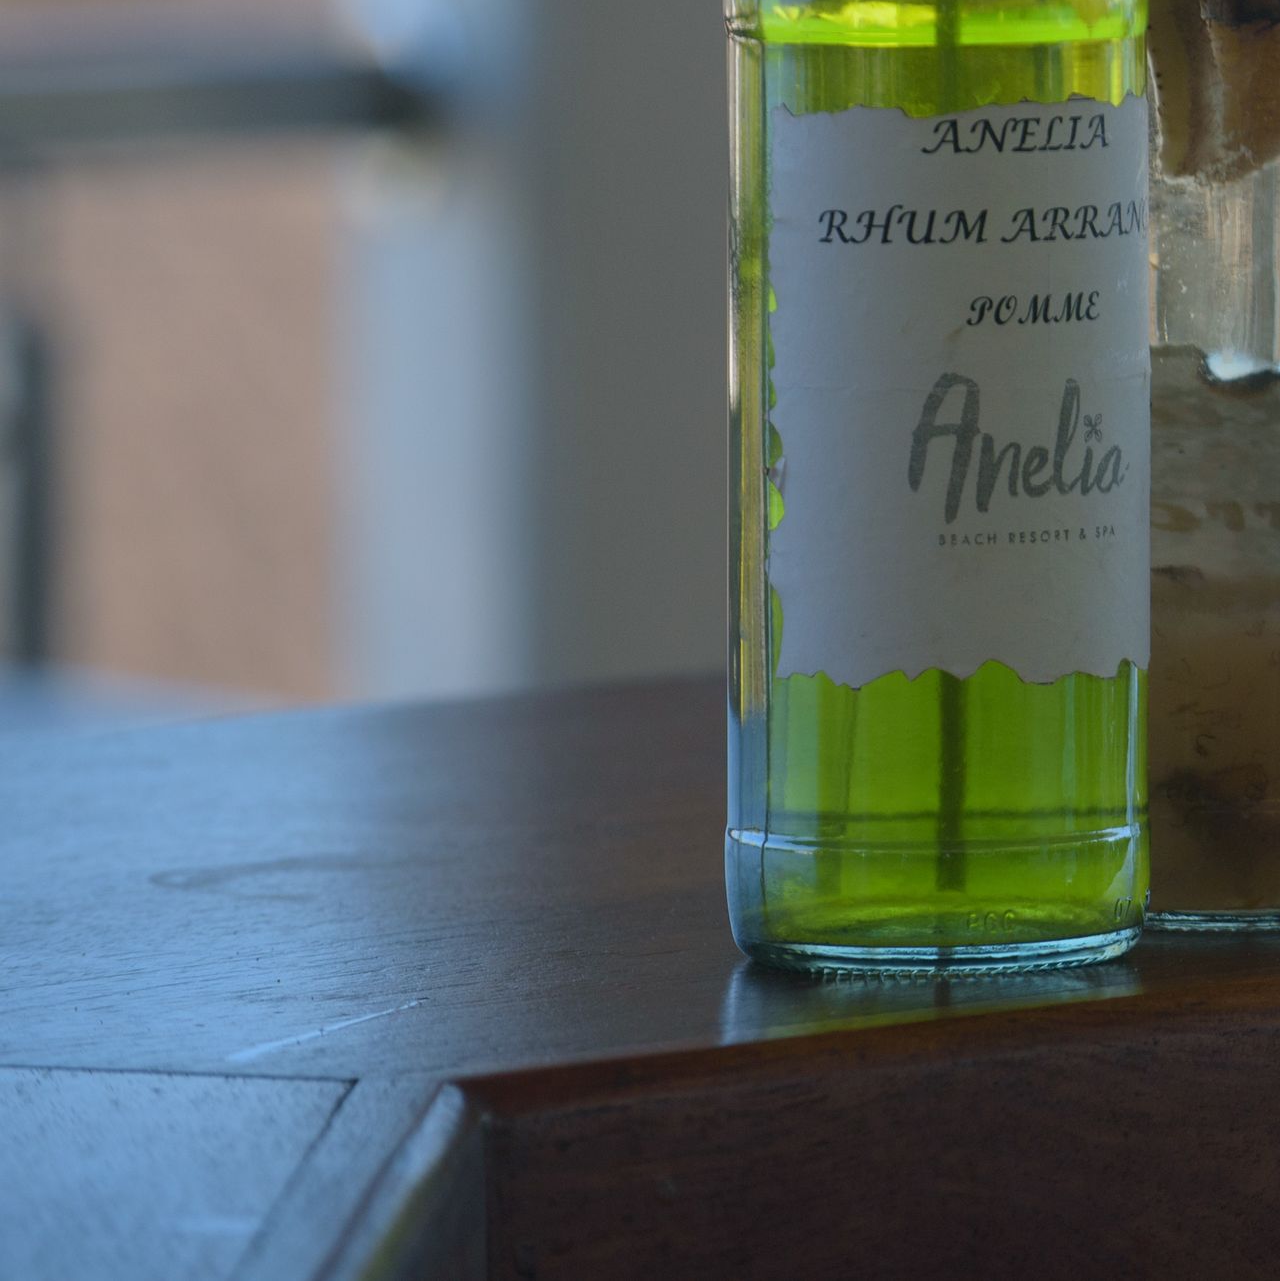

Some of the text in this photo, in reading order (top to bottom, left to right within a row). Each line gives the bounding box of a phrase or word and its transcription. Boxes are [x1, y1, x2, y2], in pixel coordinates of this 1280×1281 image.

[921, 113, 1110, 155] ANELIA
[818, 204, 989, 246] RHUM
[965, 289, 1101, 327] POMME
[907, 371, 1131, 525] Anelia
[937, 524, 1116, 546] BEACH RESORT & SPA
